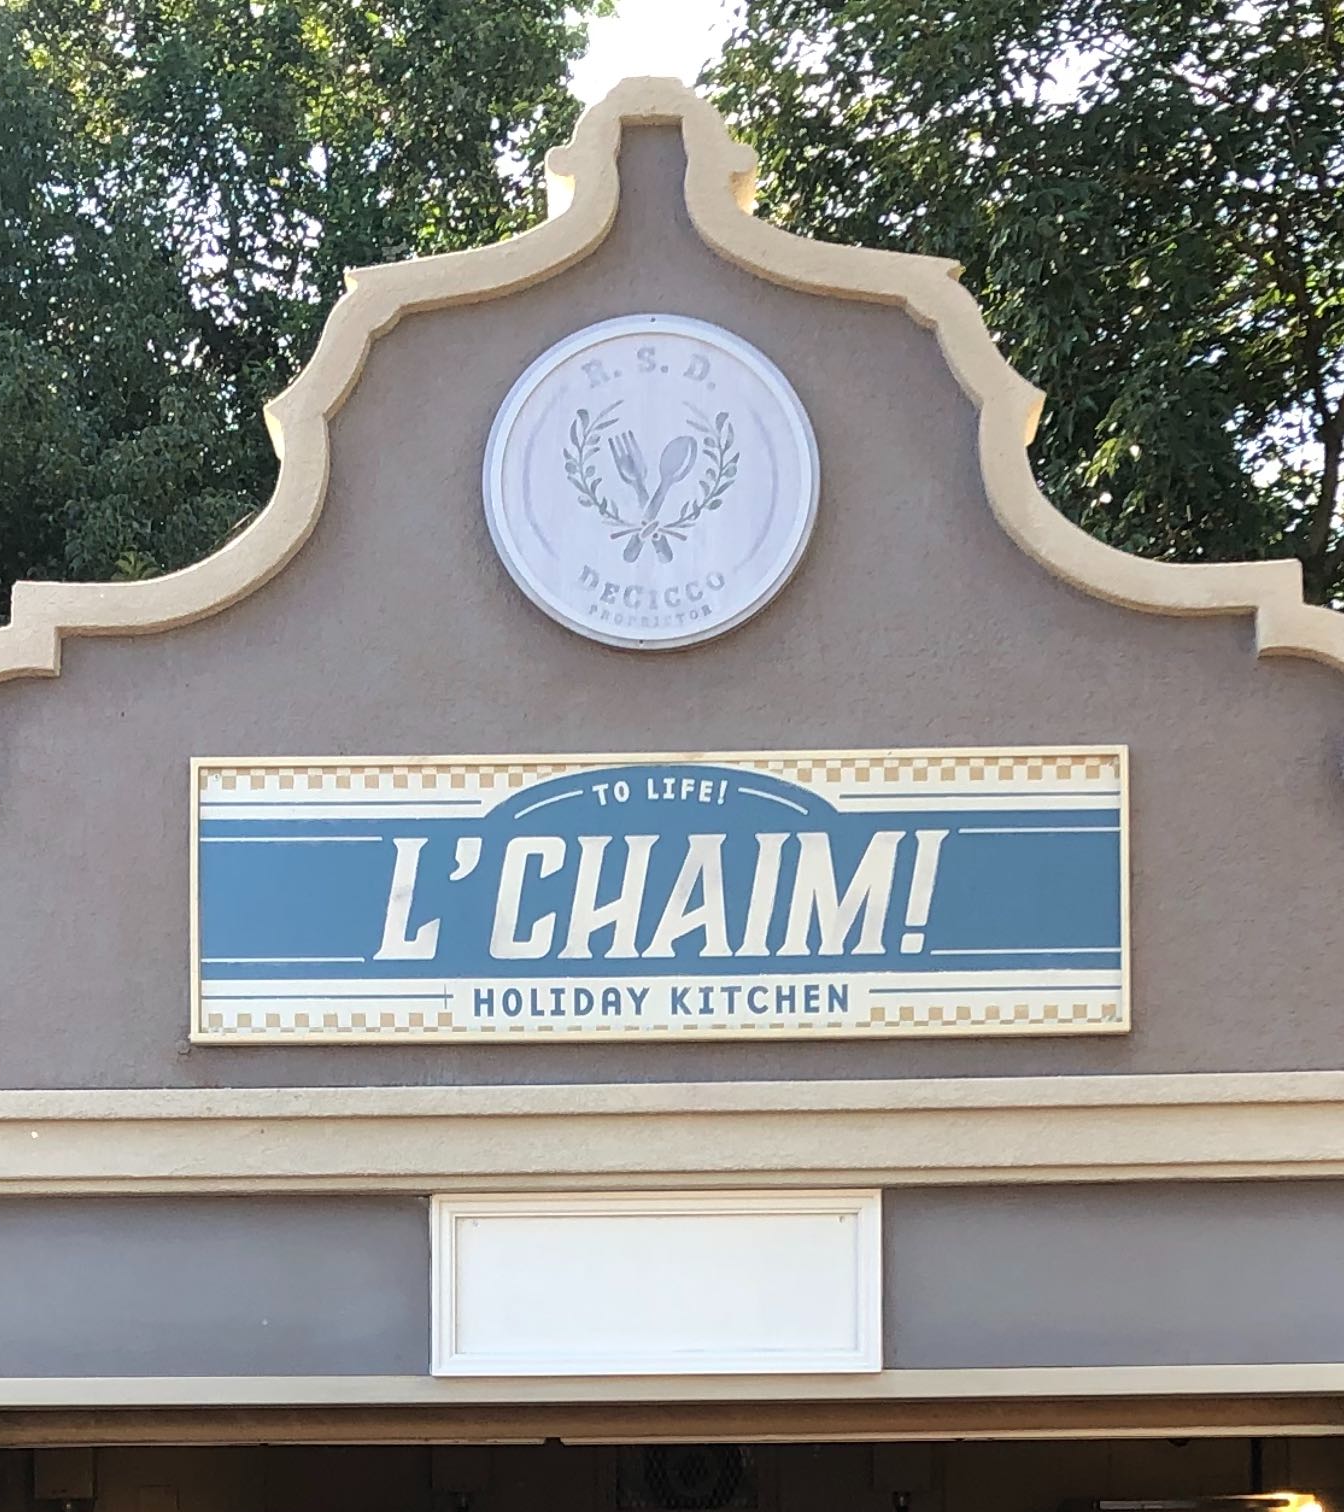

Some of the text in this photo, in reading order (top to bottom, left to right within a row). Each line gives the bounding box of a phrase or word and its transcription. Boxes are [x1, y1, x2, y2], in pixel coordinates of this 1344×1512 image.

[592, 777, 728, 806] TO LIFE!
[372, 829, 950, 960] L'CHAIM!
[473, 983, 849, 1017] HOLIDAY KITCHEN
